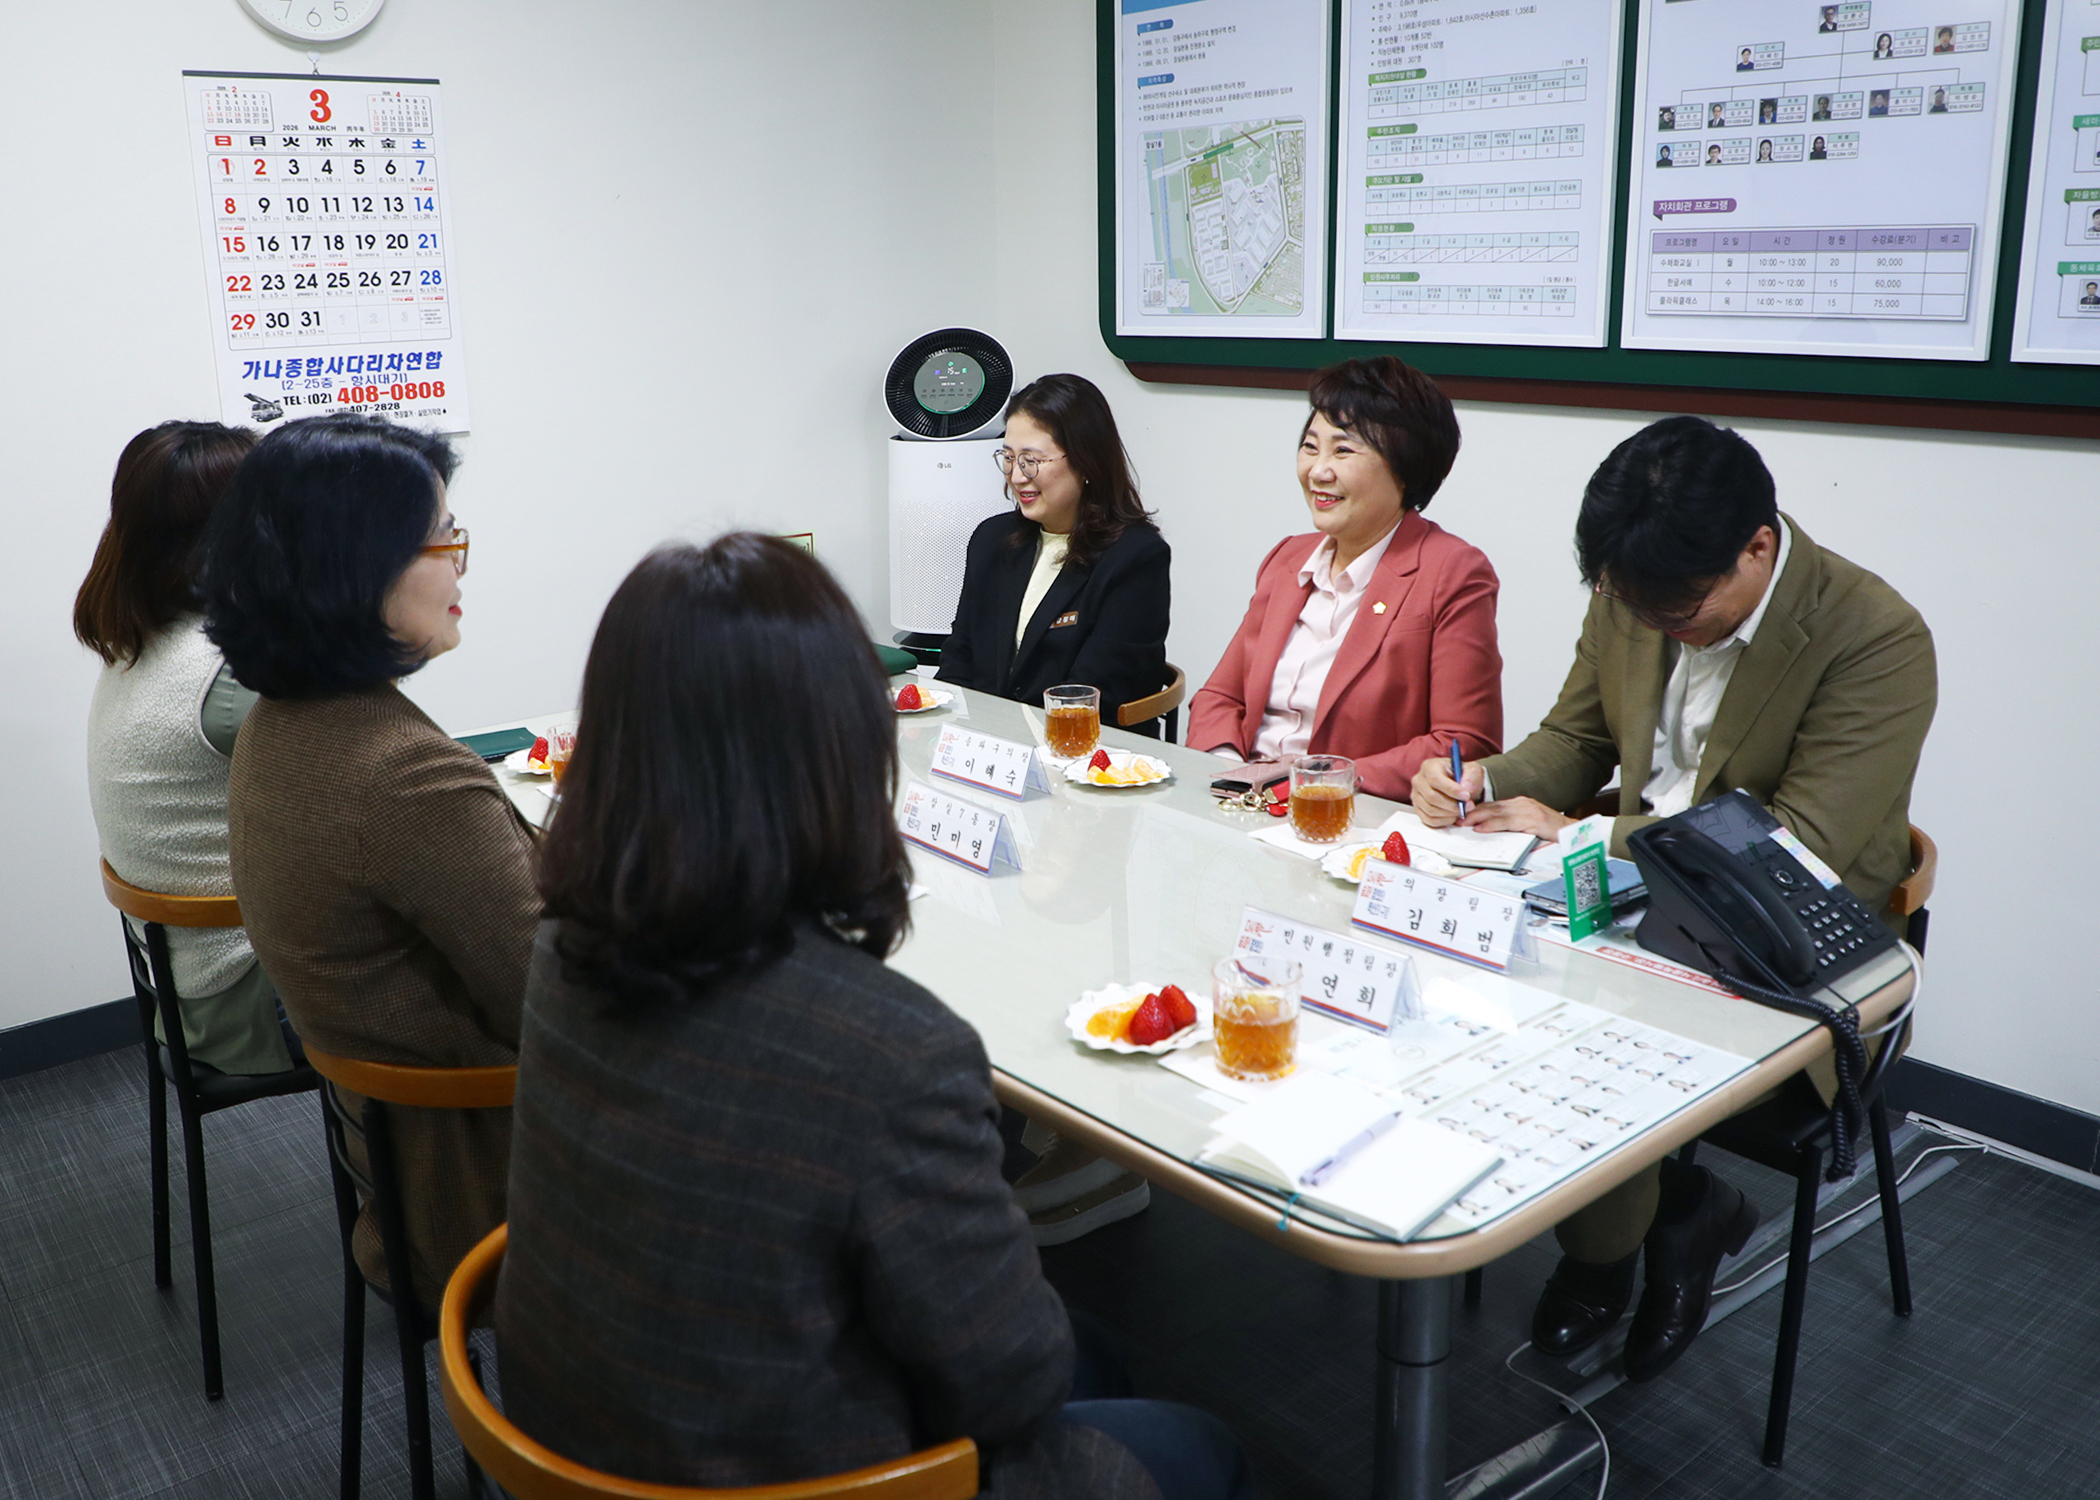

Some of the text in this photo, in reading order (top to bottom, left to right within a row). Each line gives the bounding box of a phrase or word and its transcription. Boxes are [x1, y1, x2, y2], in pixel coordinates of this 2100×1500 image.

[279, 0, 292, 19] 7
[306, 7, 322, 27] 6
[334, 1, 348, 21] 5
[310, 89, 331, 123] 3
[215, 136, 426, 149] 日 月 火 水 木 金 土
[222, 158, 425, 175] 1 2 3 4 5 6 7
[2073, 190, 2100, 199] 자율방
[225, 197, 434, 214] 8 9 10 11 12 13 14
[1659, 200, 1729, 212] 자치회관 프로그램
[223, 234, 437, 252] 15 16 17 18 19 20 21
[1666, 238, 1697, 247] 프로그램명
[1871, 234, 1916, 245] 수강료(분기)
[1830, 258, 1839, 266] 20
[1877, 258, 1903, 267] 90,000
[227, 270, 442, 292] 22 23 24 25 26 27 28
[1668, 278, 1692, 287] 한글서예
[1829, 279, 1838, 287] 15
[1875, 280, 1901, 288] 60,000
[1874, 299, 1900, 308] 75,000
[231, 314, 255, 330] 29
[266, 312, 289, 328] 30
[301, 311, 320, 327] 31
[242, 351, 442, 380] 가나종합사다리차연합
[351, 373, 408, 386] 항시대기)
[337, 381, 445, 404] 408-0808
[350, 402, 400, 412] 407-2828
